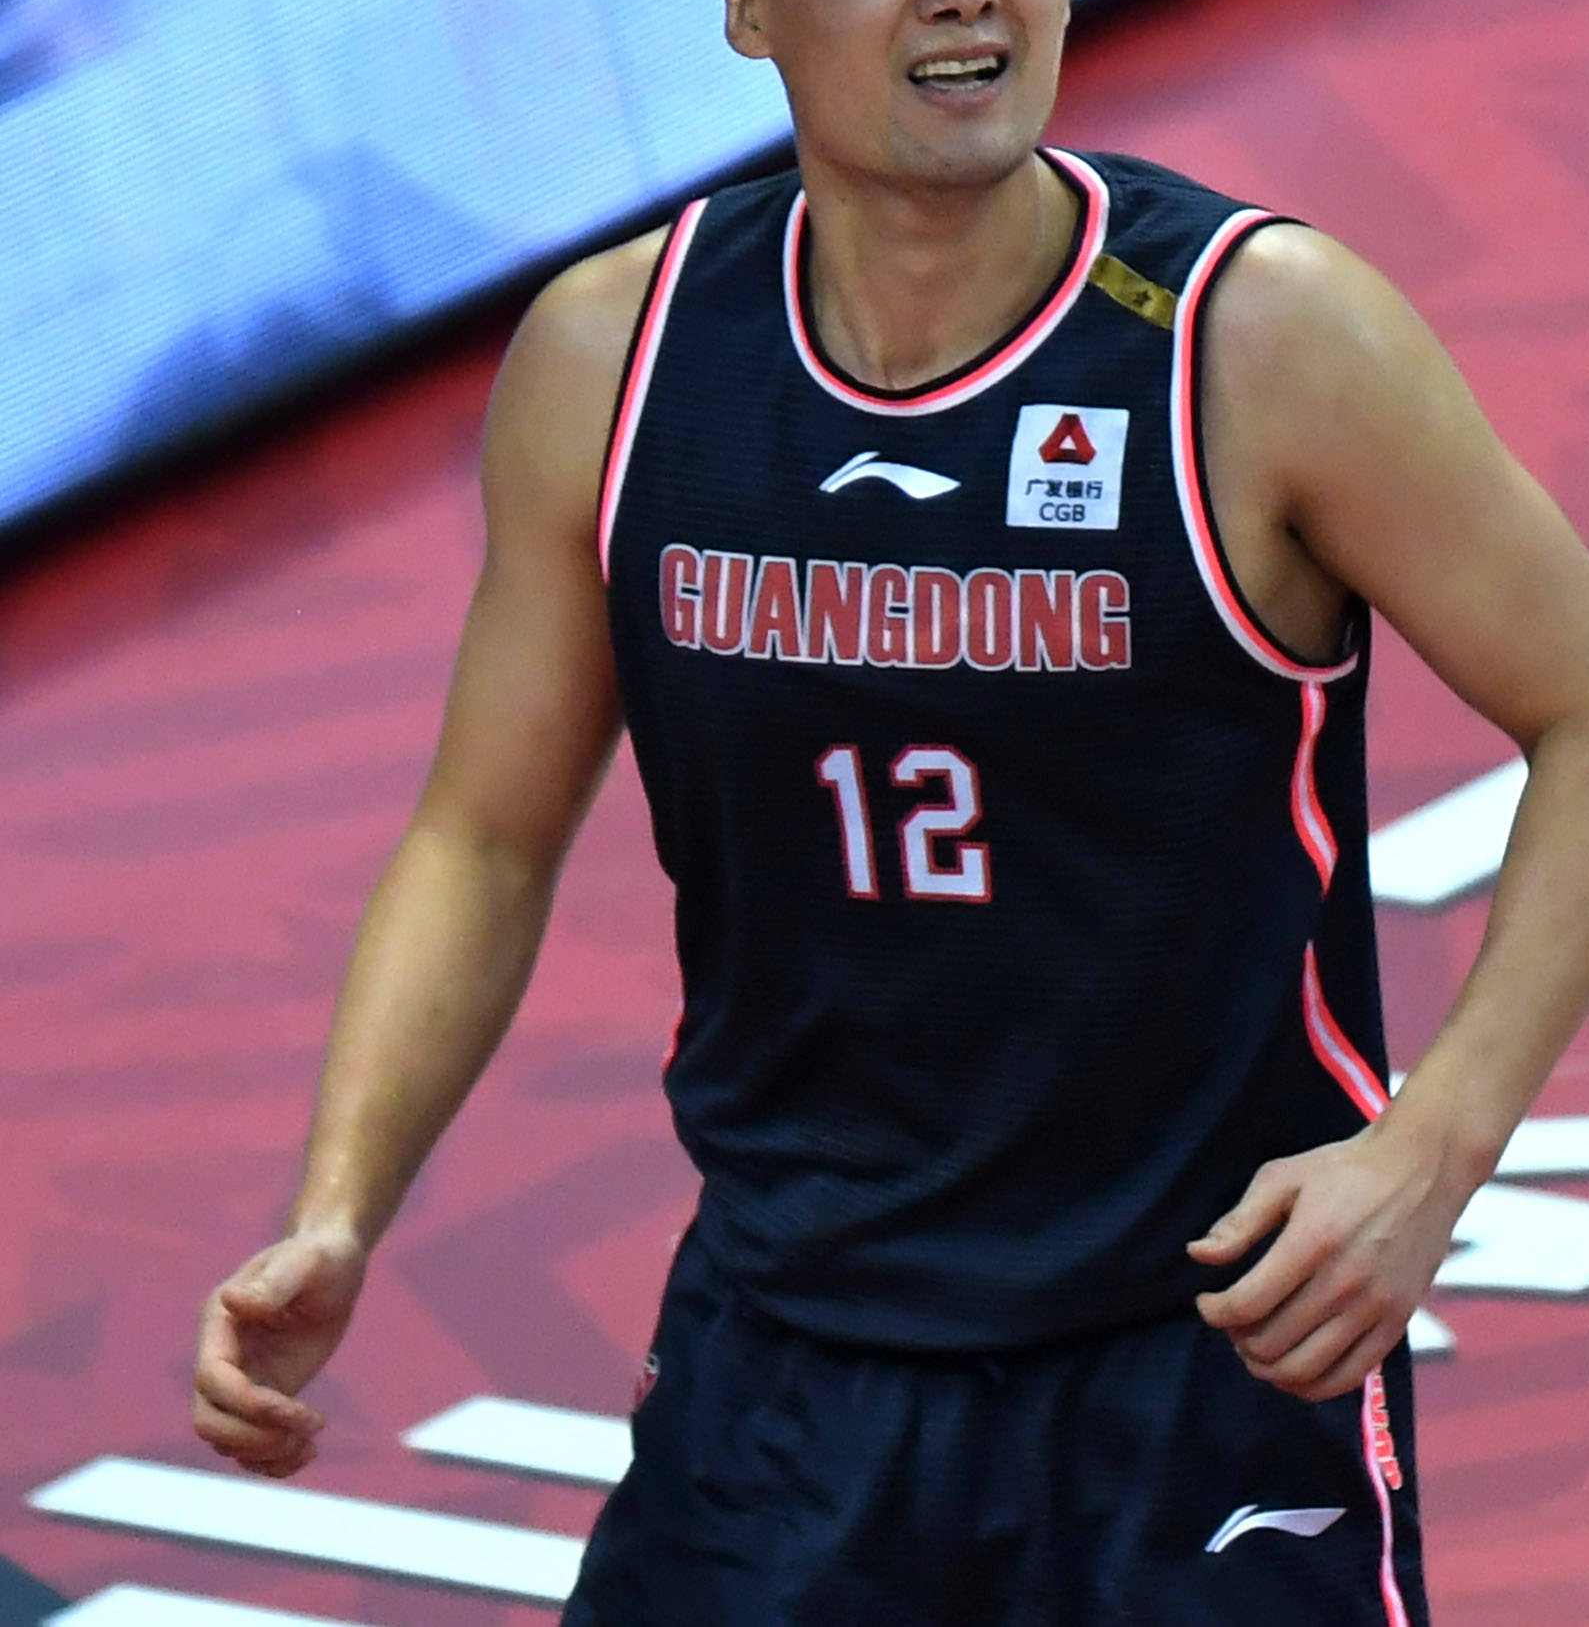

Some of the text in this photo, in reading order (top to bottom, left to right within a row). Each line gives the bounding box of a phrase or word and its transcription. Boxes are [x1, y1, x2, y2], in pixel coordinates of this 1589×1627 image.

[1038, 502, 1086, 523] CGB
[659, 542, 1132, 672] GUANGDONG
[815, 743, 991, 904] 12
